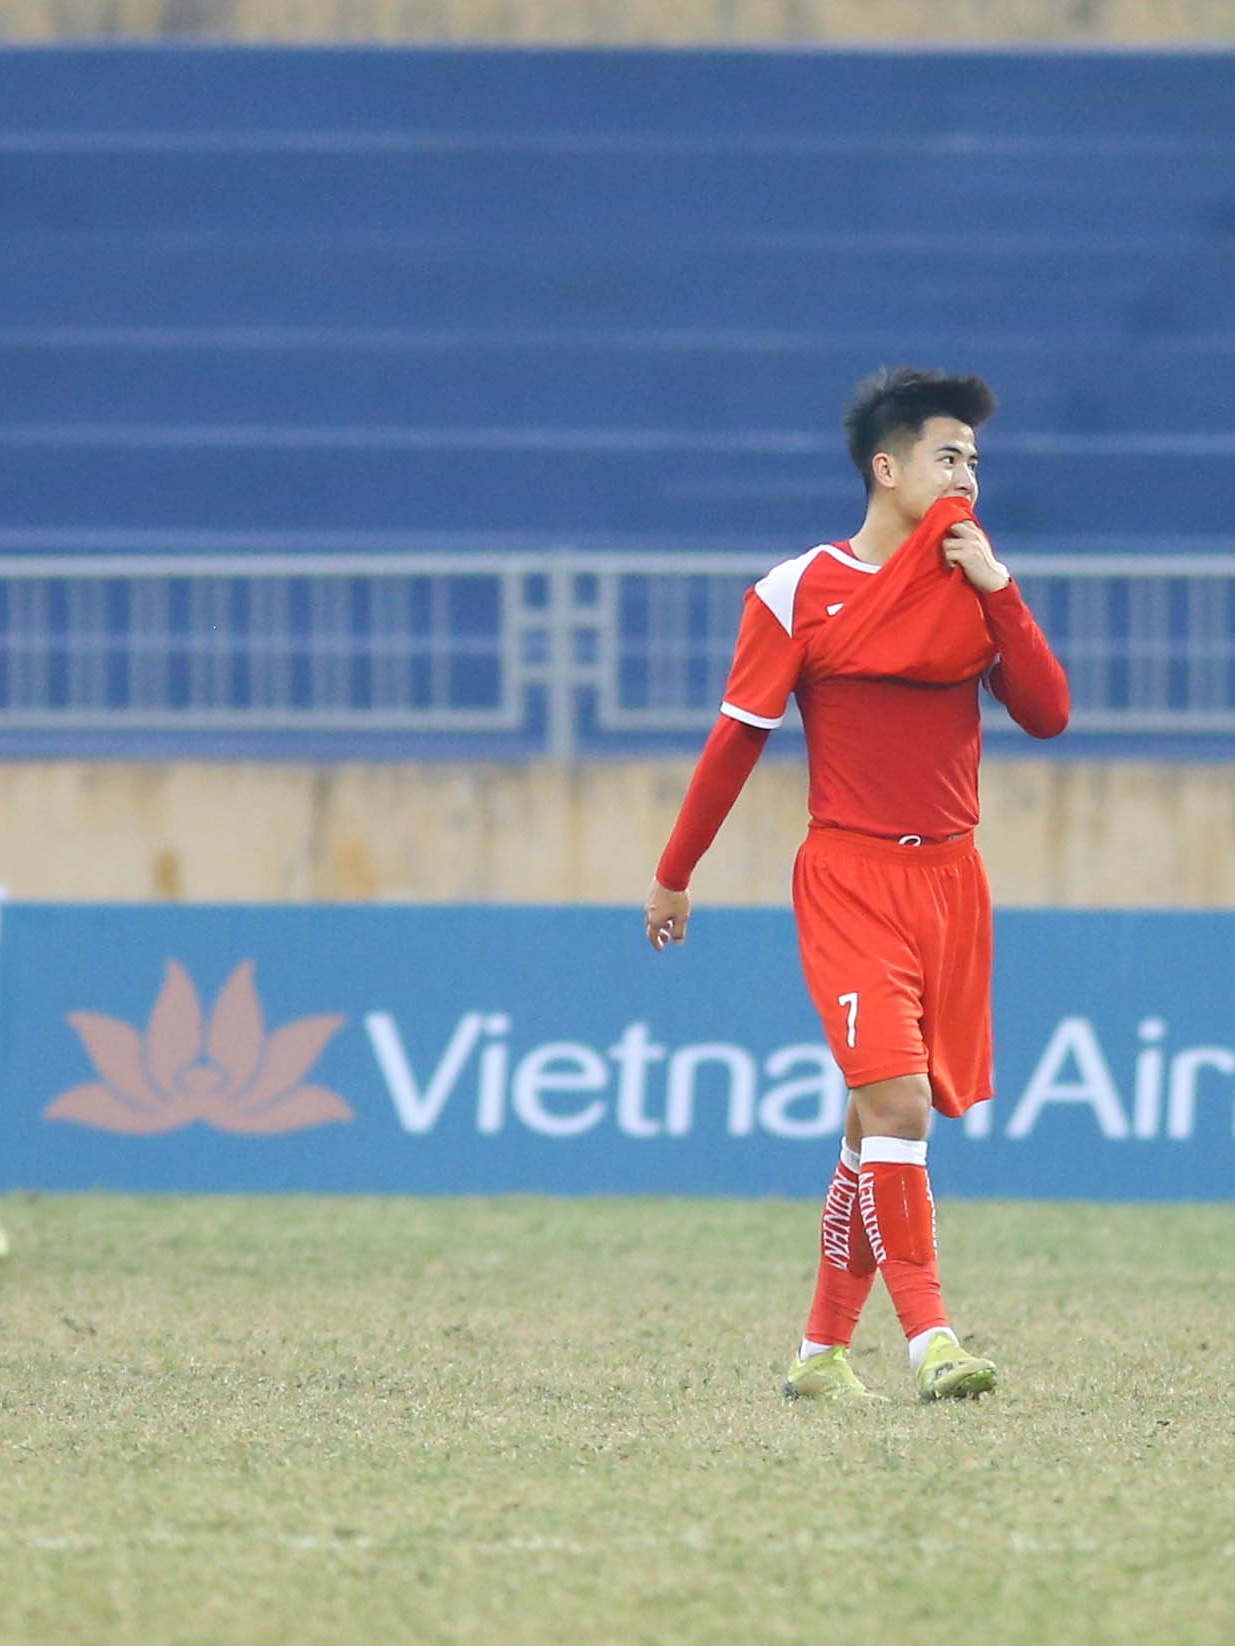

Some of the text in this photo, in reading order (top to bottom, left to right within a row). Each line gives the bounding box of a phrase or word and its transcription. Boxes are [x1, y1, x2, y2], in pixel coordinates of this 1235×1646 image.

[838, 992, 859, 1049] 7
[363, 1011, 1235, 1140] Vietna Air
